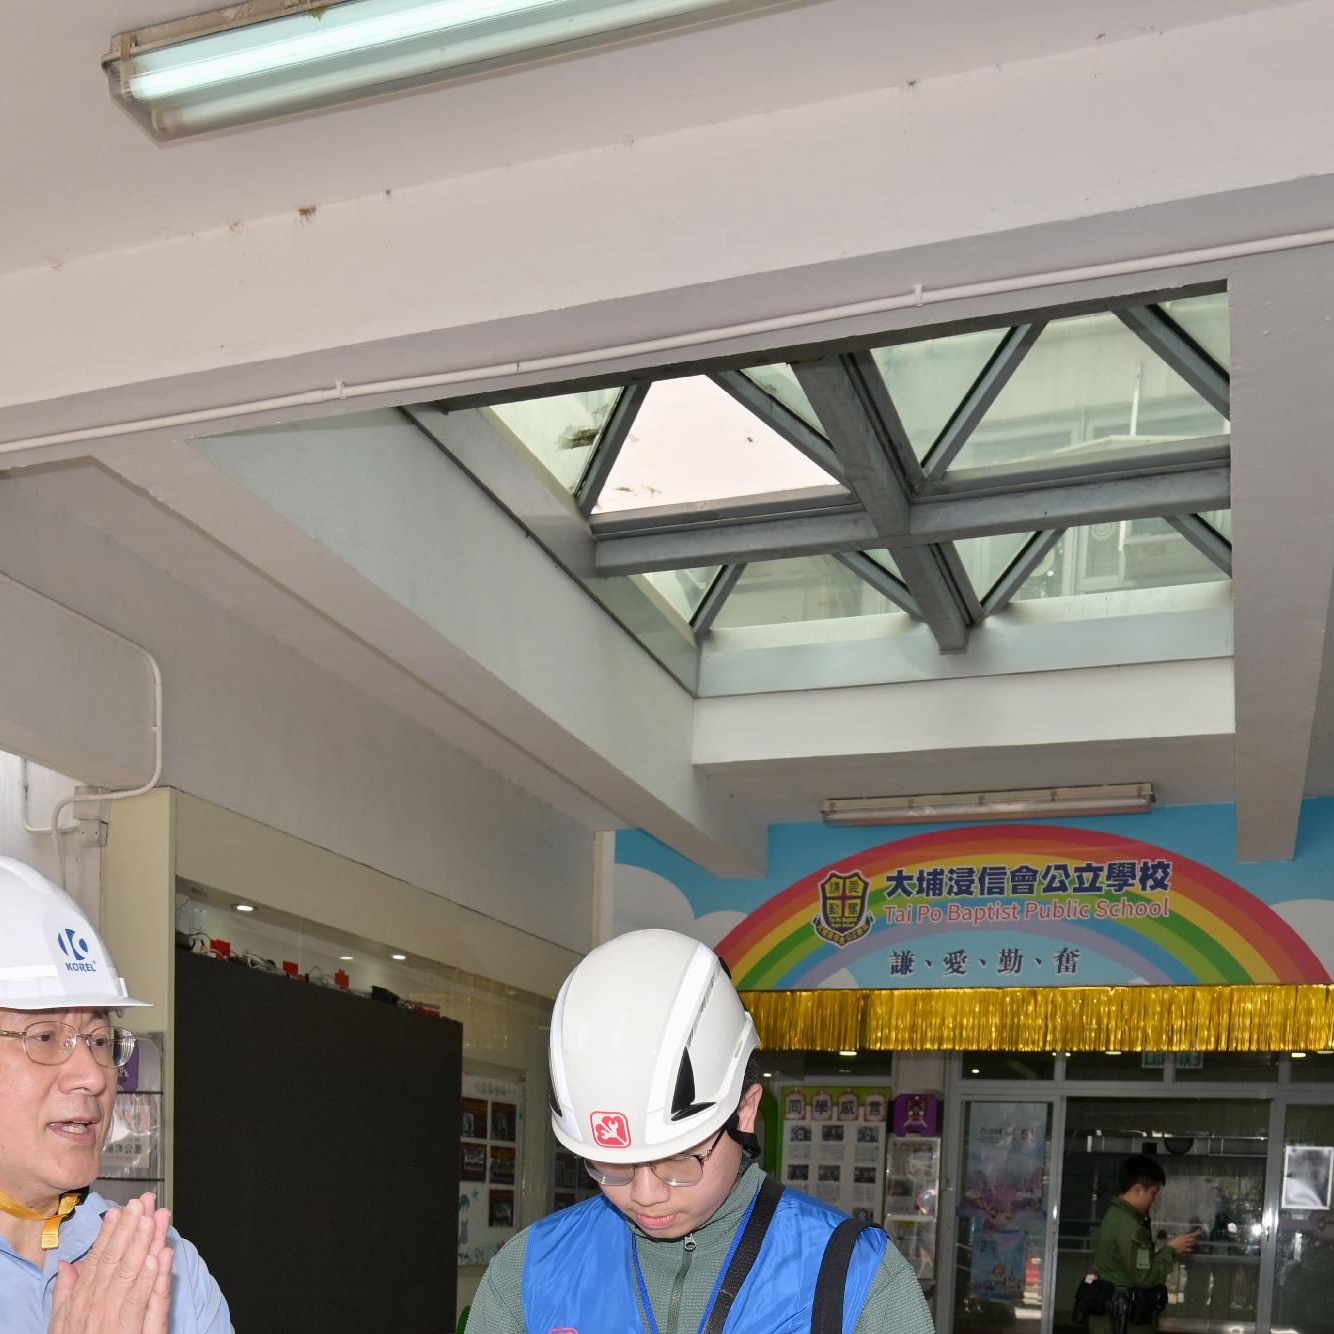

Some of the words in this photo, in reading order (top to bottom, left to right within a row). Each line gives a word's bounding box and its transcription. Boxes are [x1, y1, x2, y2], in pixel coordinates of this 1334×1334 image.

[885, 861, 1171, 898] 大埔浸信會公立學校
[884, 905, 912, 923] Tai
[918, 905, 942, 922] Po
[948, 902, 1019, 925] Baptist
[1025, 900, 1090, 920] Public
[1095, 898, 1170, 918] School
[65, 962, 97, 973] KOREL
